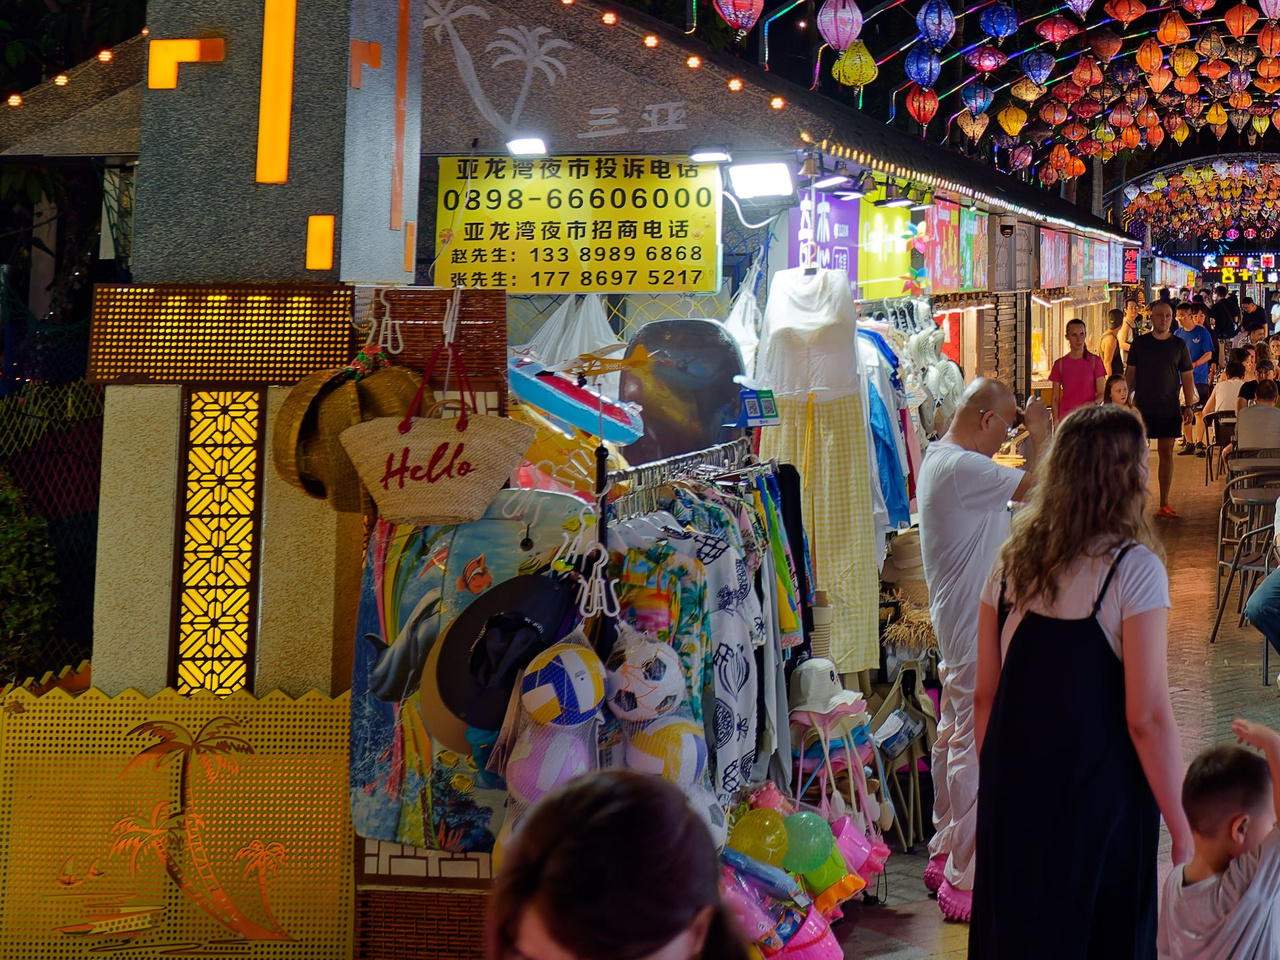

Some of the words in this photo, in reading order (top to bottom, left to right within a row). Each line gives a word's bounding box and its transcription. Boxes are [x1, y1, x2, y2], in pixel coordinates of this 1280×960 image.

[577, 102, 688, 138] 三亚
[456, 158, 699, 180] 亚龙湾夜市投诉电话
[443, 187, 713, 211] 0898-66606000
[463, 220, 689, 240] 亚龙湾夜市招商电话
[529, 247, 569, 262] 133
[579, 247, 636, 262] 8989
[645, 247, 703, 262] 6868
[531, 271, 569, 287] 177
[580, 271, 637, 287] 8697
[648, 270, 703, 287] 5217
[379, 442, 480, 490] Hello
